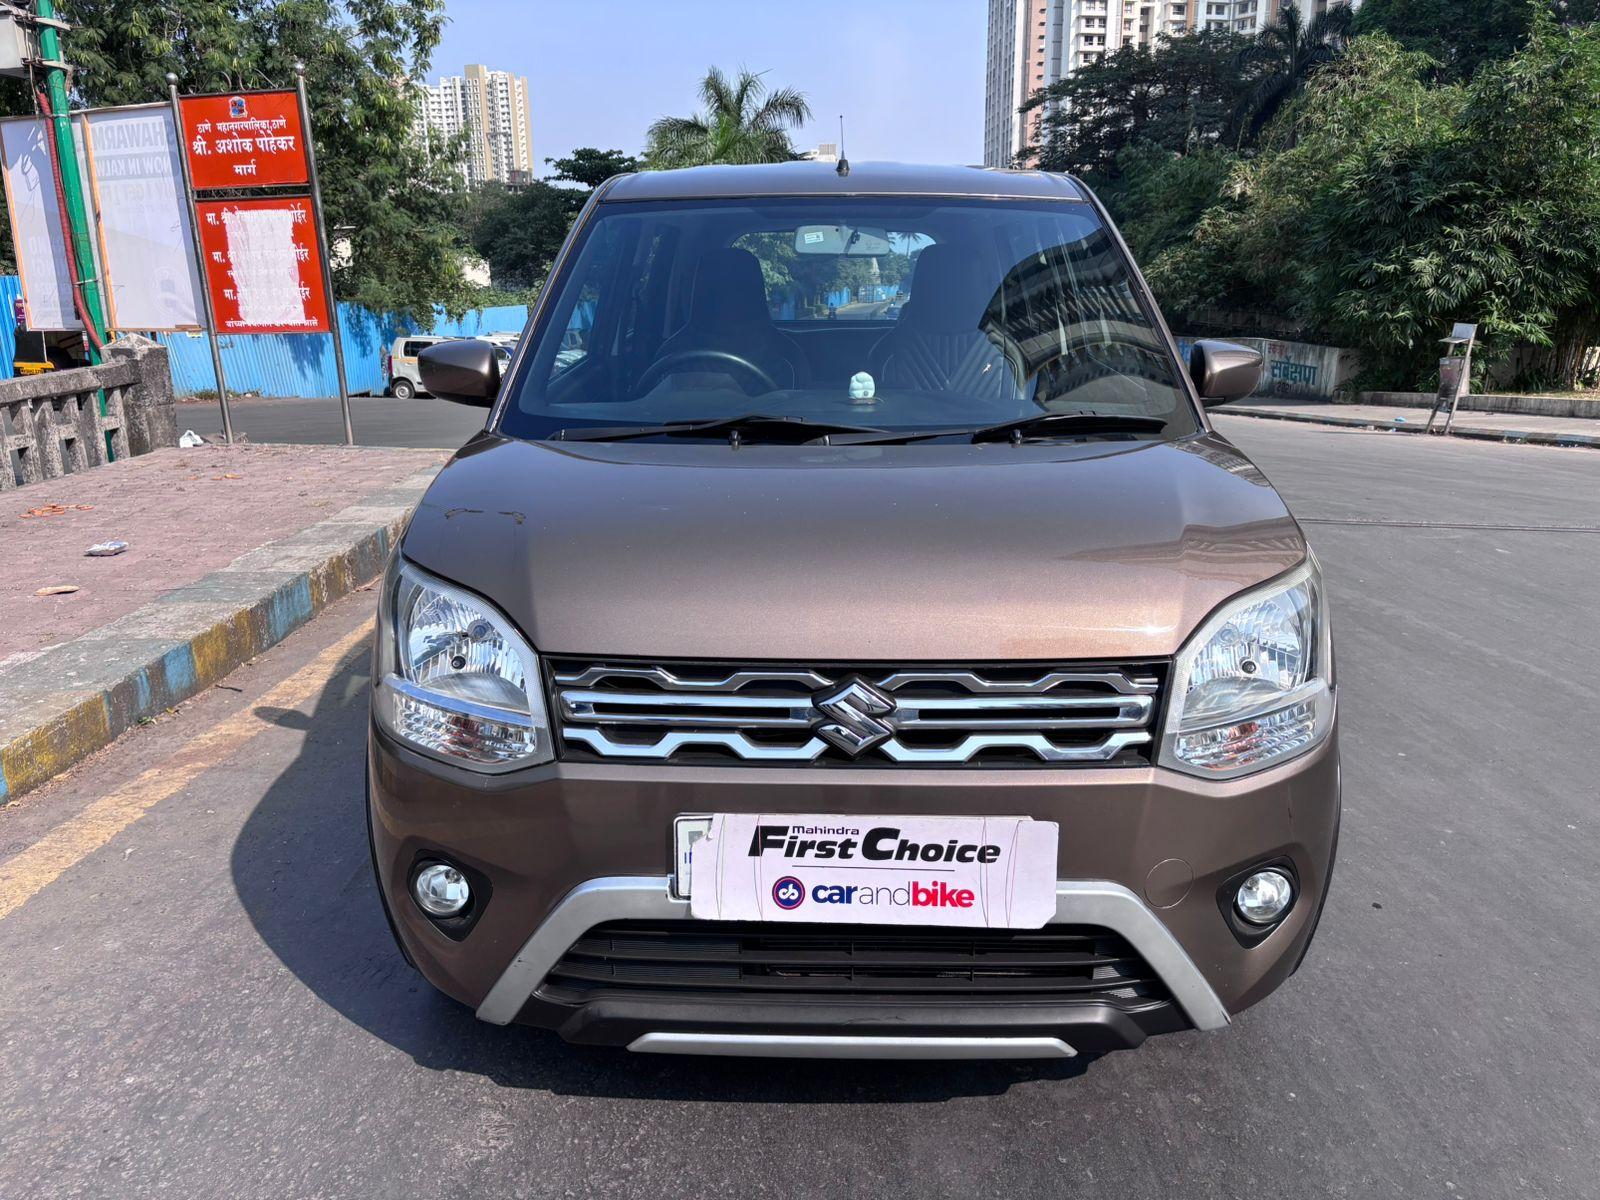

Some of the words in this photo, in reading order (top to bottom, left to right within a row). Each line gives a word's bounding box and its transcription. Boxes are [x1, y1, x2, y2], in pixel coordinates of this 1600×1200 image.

[196, 119, 212, 134] ठाणे
[192, 135, 211, 155] श्री.
[215, 131, 254, 154] अशोक
[233, 159, 257, 176] मार्ग
[792, 825, 860, 836] Mahindra
[748, 825, 858, 860] First
[861, 827, 1001, 864] Choice
